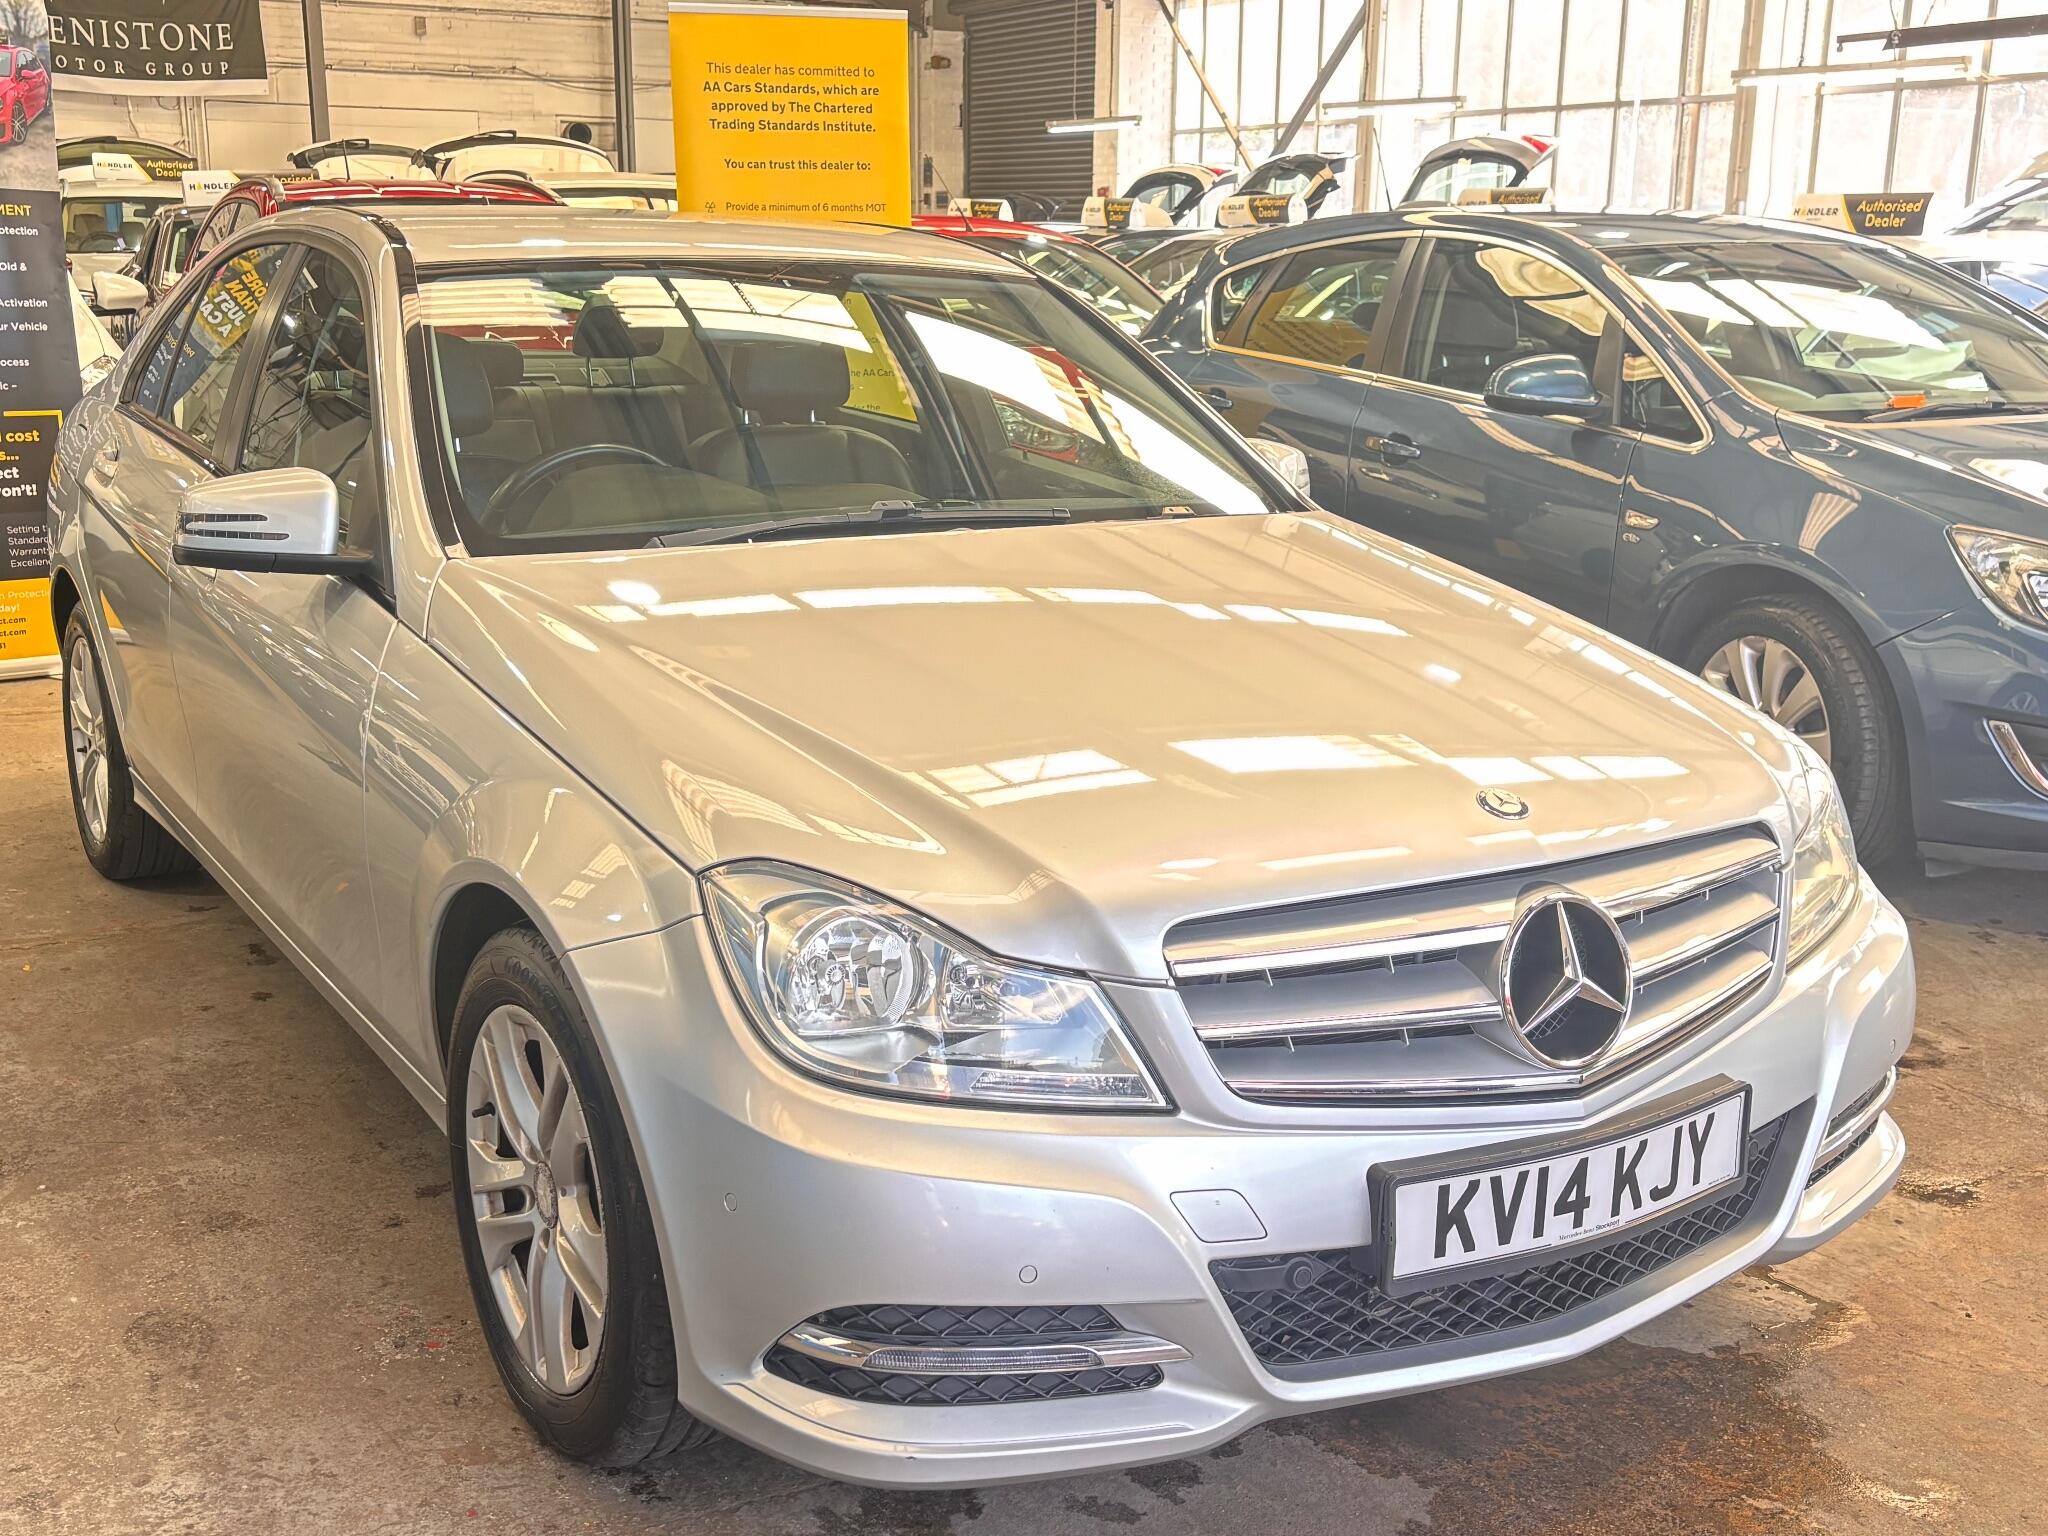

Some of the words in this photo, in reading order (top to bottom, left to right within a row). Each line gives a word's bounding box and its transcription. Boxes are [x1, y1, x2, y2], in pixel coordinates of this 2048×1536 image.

[145, 61, 229, 76] GROUP
[706, 62, 731, 74] This
[734, 64, 771, 75] dealer
[774, 64, 795, 76] has
[798, 65, 860, 77] committed
[864, 67, 875, 78] to
[703, 81, 721, 92] AA
[724, 82, 752, 93] Cars
[754, 82, 820, 96] Standards,
[823, 84, 858, 96] which
[861, 87, 880, 96] are
[711, 101, 768, 113] approved
[772, 102, 786, 114] by
[789, 102, 811, 113] The
[814, 102, 873, 114] Chartered
[709, 118, 755, 132] Trading
[758, 120, 820, 131] Standards
[823, 121, 876, 132] Institute.
[146, 160, 194, 170] Authorised
[724, 158, 744, 169] You
[747, 161, 766, 169] can
[769, 160, 795, 170] trust
[799, 160, 818, 170] this
[820, 160, 854, 170] dealer
[857, 162, 871, 170] to:
[156, 169, 182, 177] Deale
[726, 202, 760, 212] Provide
[762, 204, 767, 212] a
[769, 203, 810, 212] minimum
[812, 203, 821, 212] of
[822, 203, 829, 212] 6
[831, 204, 864, 212] months
[866, 204, 886, 212] MOT
[1856, 198, 1924, 213] Authorised
[1258, 208, 1280, 218] Dealer
[1865, 214, 1906, 228] Dealer
[0, 226, 38, 236] otection
[0, 262, 17, 271] Old
[20, 262, 28, 272] &
[0, 298, 48, 308] Activation
[10, 322, 48, 331] Vehicle
[0, 359, 30, 367] ocess
[863, 369, 876, 377] AA
[6, 430, 40, 442] cost
[0, 484, 38, 497] on't!
[6, 525, 40, 534] Setting
[9, 548, 49, 556] Warrant
[10, 558, 50, 568] Excellen
[1434, 1156, 1590, 1259] KV14
[1610, 1112, 1716, 1218] KJY
[1596, 1219, 1620, 1232] Stockport
